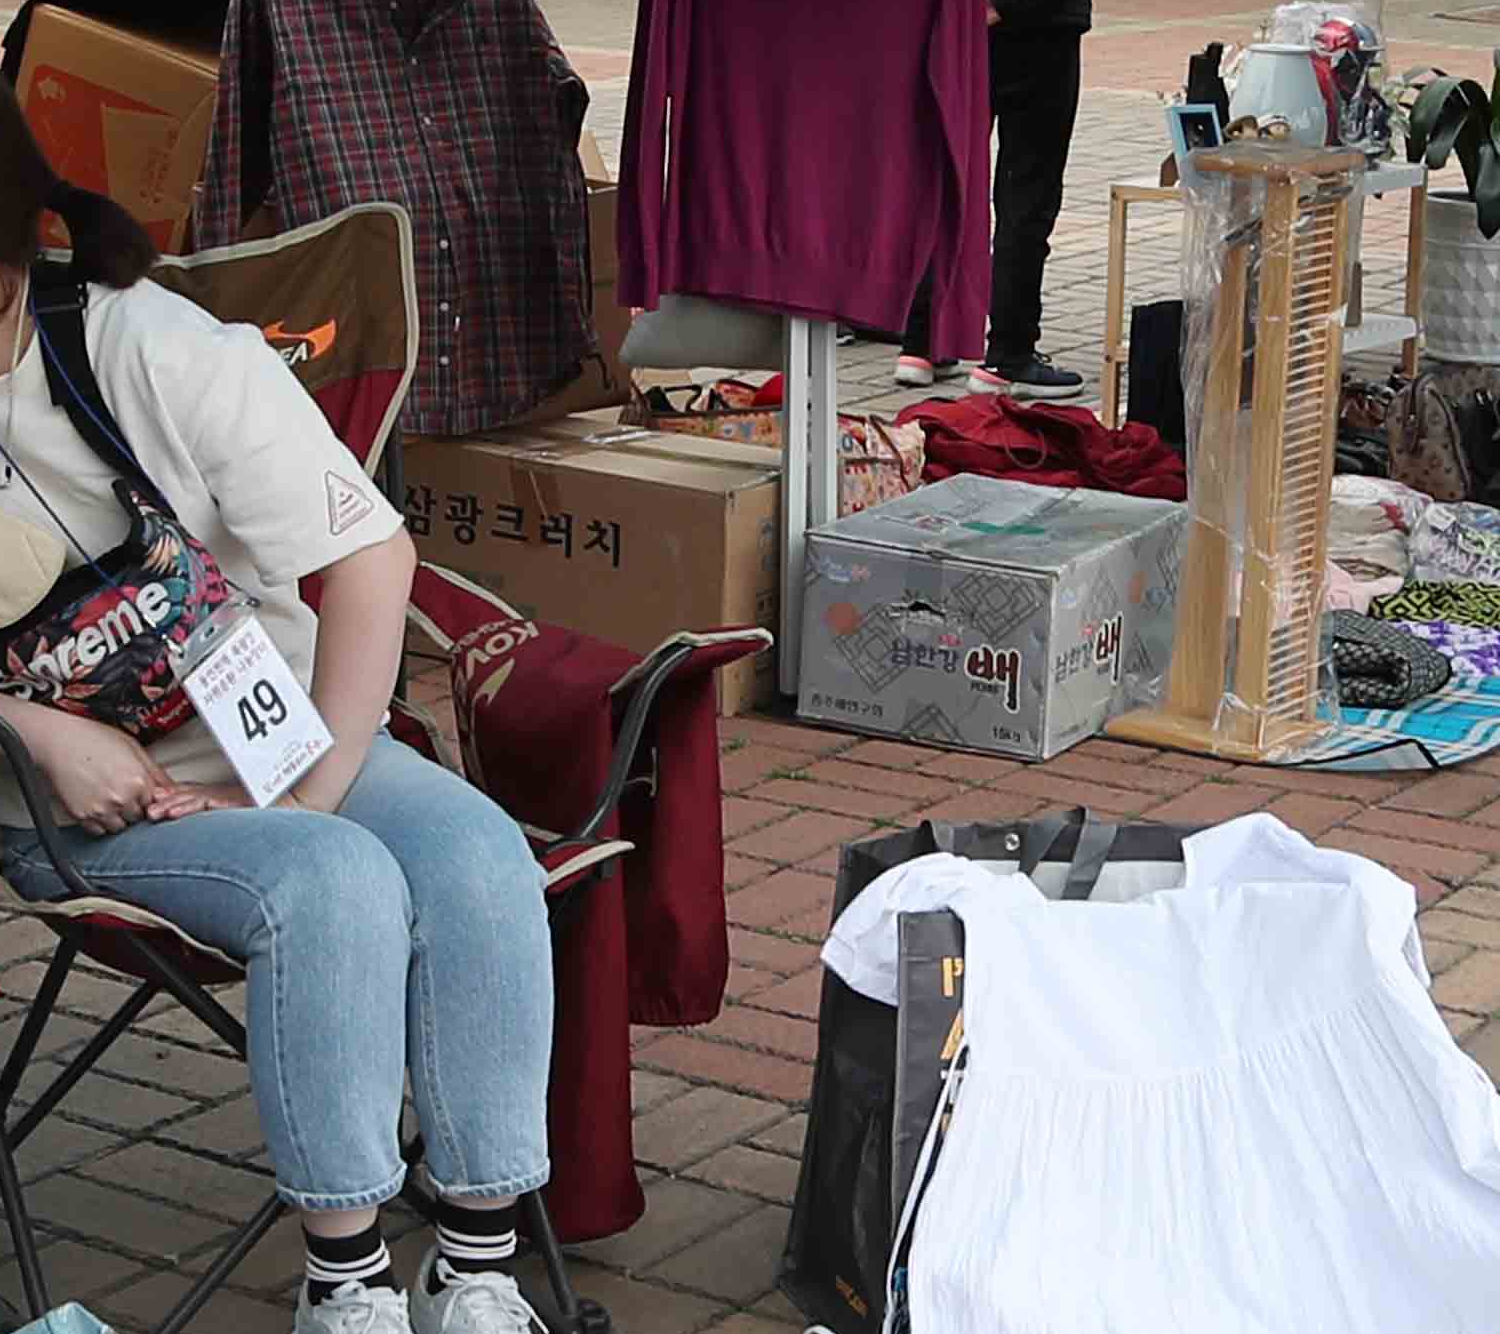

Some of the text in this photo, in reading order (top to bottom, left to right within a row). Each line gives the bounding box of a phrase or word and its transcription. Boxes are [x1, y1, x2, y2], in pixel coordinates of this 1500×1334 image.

[404, 483, 622, 569] 삼광크러치
[237, 678, 288, 742] 49
[966, 644, 1020, 712] 배
